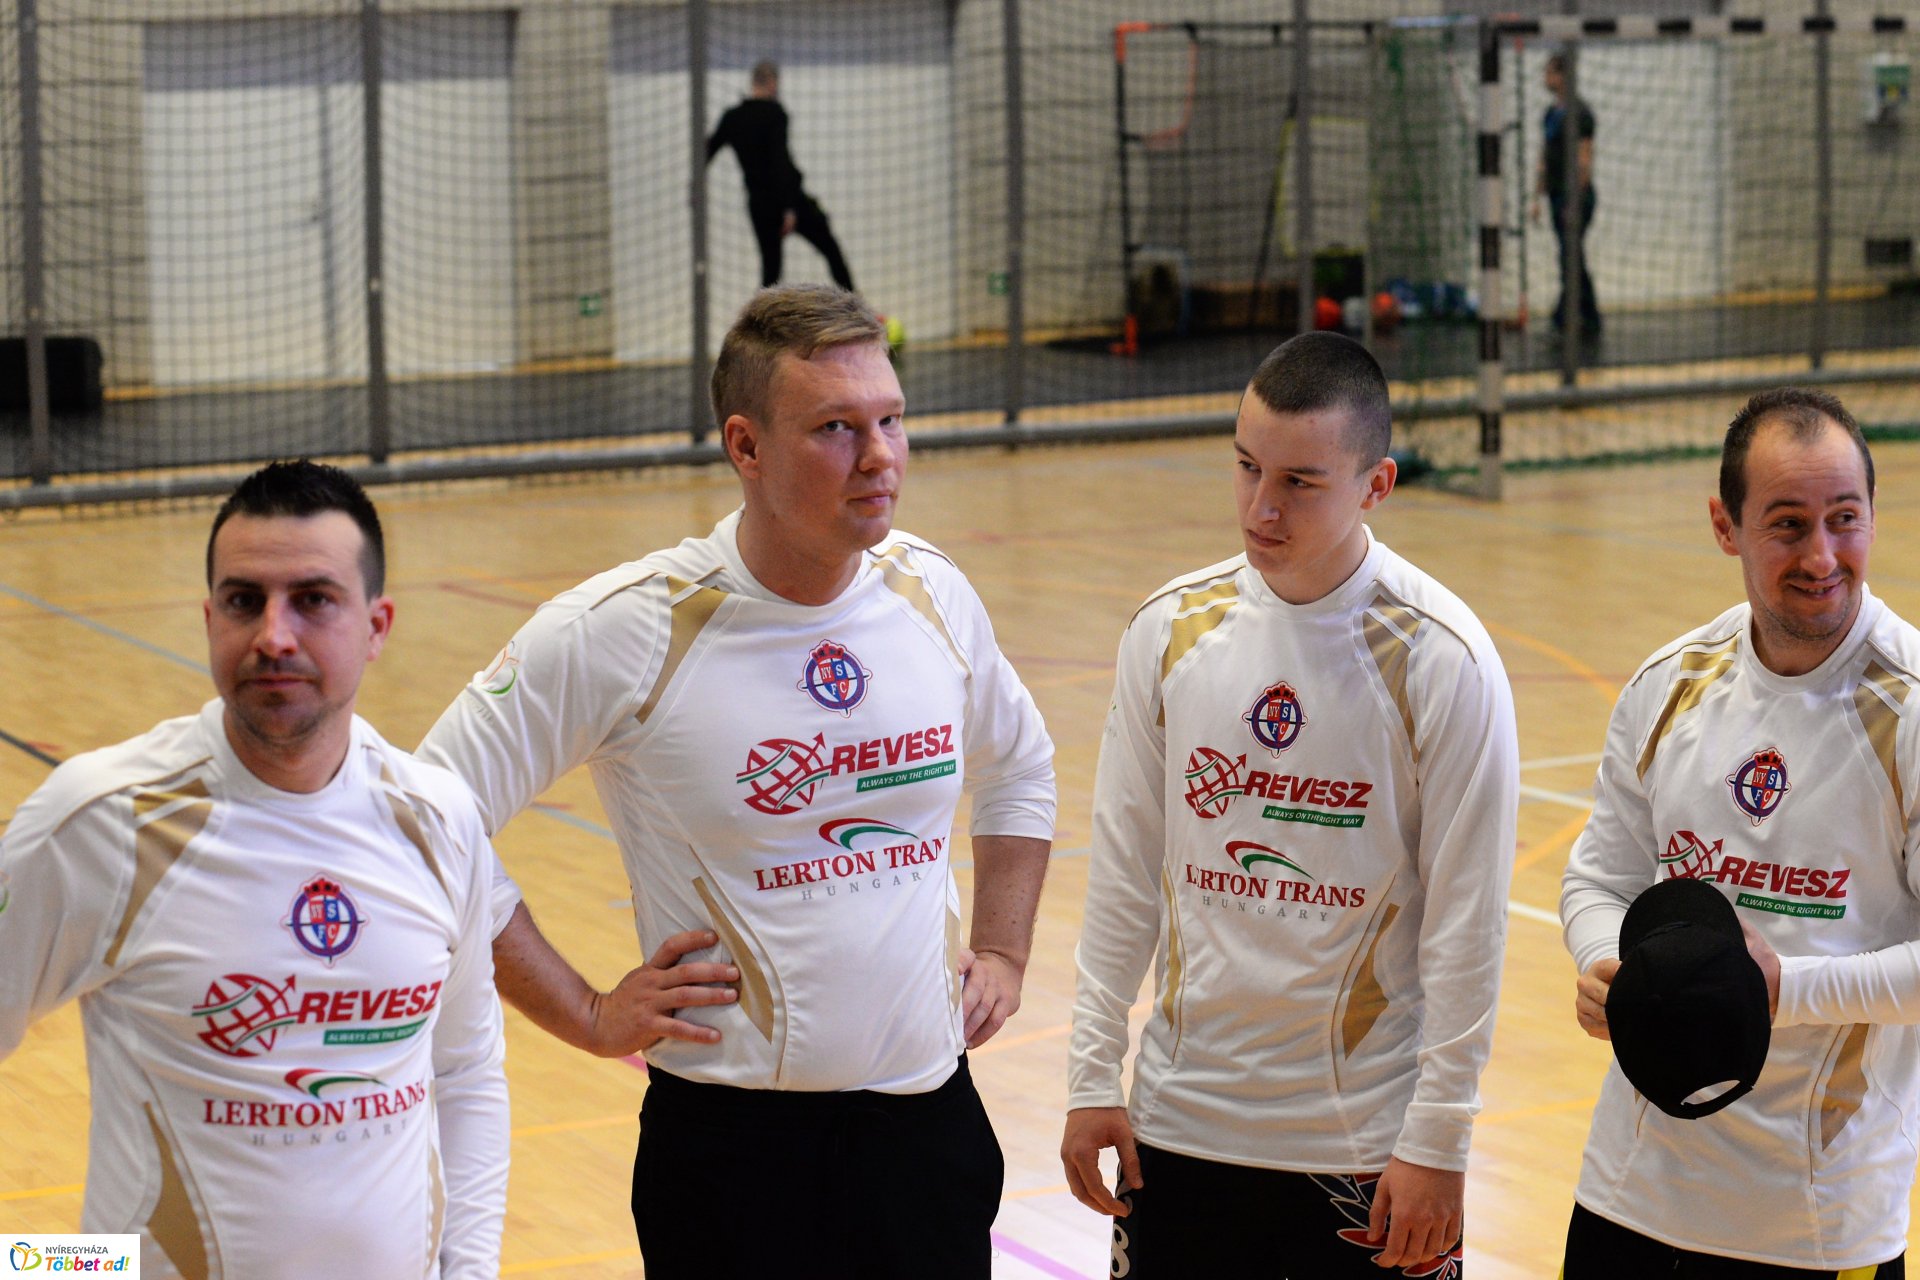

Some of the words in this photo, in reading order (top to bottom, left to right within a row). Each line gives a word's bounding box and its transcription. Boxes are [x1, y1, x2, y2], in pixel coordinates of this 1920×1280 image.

[836, 664, 843, 676] S
[839, 681, 848, 693] C
[1282, 705, 1289, 718] S
[1279, 723, 1286, 734] C
[829, 724, 954, 776] REVESZ
[860, 775, 894, 789] ALWAYS
[895, 771, 907, 782] ON
[909, 768, 922, 780] THE
[923, 766, 943, 777] RIGHT
[1768, 773, 1775, 785] S
[1243, 770, 1373, 808] REVESZ
[1763, 790, 1771, 802] C
[1266, 808, 1294, 819] ALWAYS
[1295, 812, 1305, 820] ON
[1319, 816, 1341, 825] RIGHT
[753, 850, 876, 891] LERTON
[1715, 855, 1850, 899] REVESZ
[1275, 880, 1366, 908] TRANS
[327, 903, 337, 918] S
[1202, 895, 1329, 922] HUNGARY
[1740, 897, 1773, 909] ALWAYS
[1774, 903, 1786, 911] ON
[1797, 907, 1821, 915] RIGHT
[1823, 908, 1842, 916] WAY
[328, 924, 336, 938] C
[297, 979, 443, 1024] REVESZ
[203, 1098, 346, 1128] LERTON
